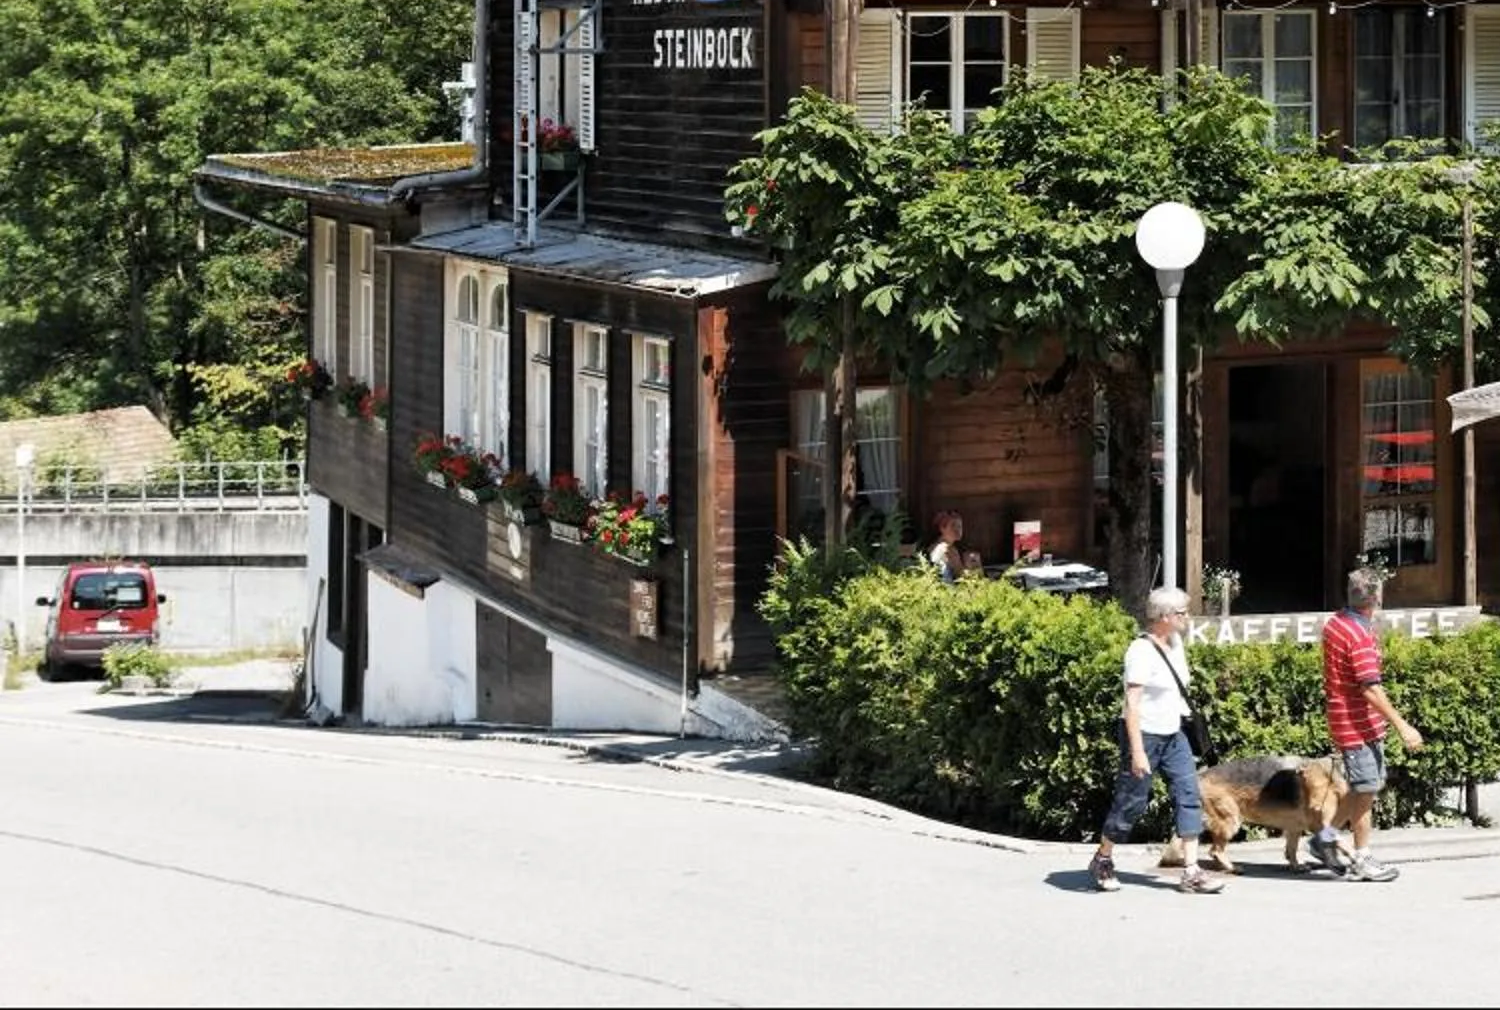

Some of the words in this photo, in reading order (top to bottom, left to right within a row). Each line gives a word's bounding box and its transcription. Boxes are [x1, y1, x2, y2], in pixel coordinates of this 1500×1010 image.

[653, 27, 753, 68] STEINBOCK
[1188, 615, 1322, 646] KAFFE
[1385, 610, 1460, 638] TEE
